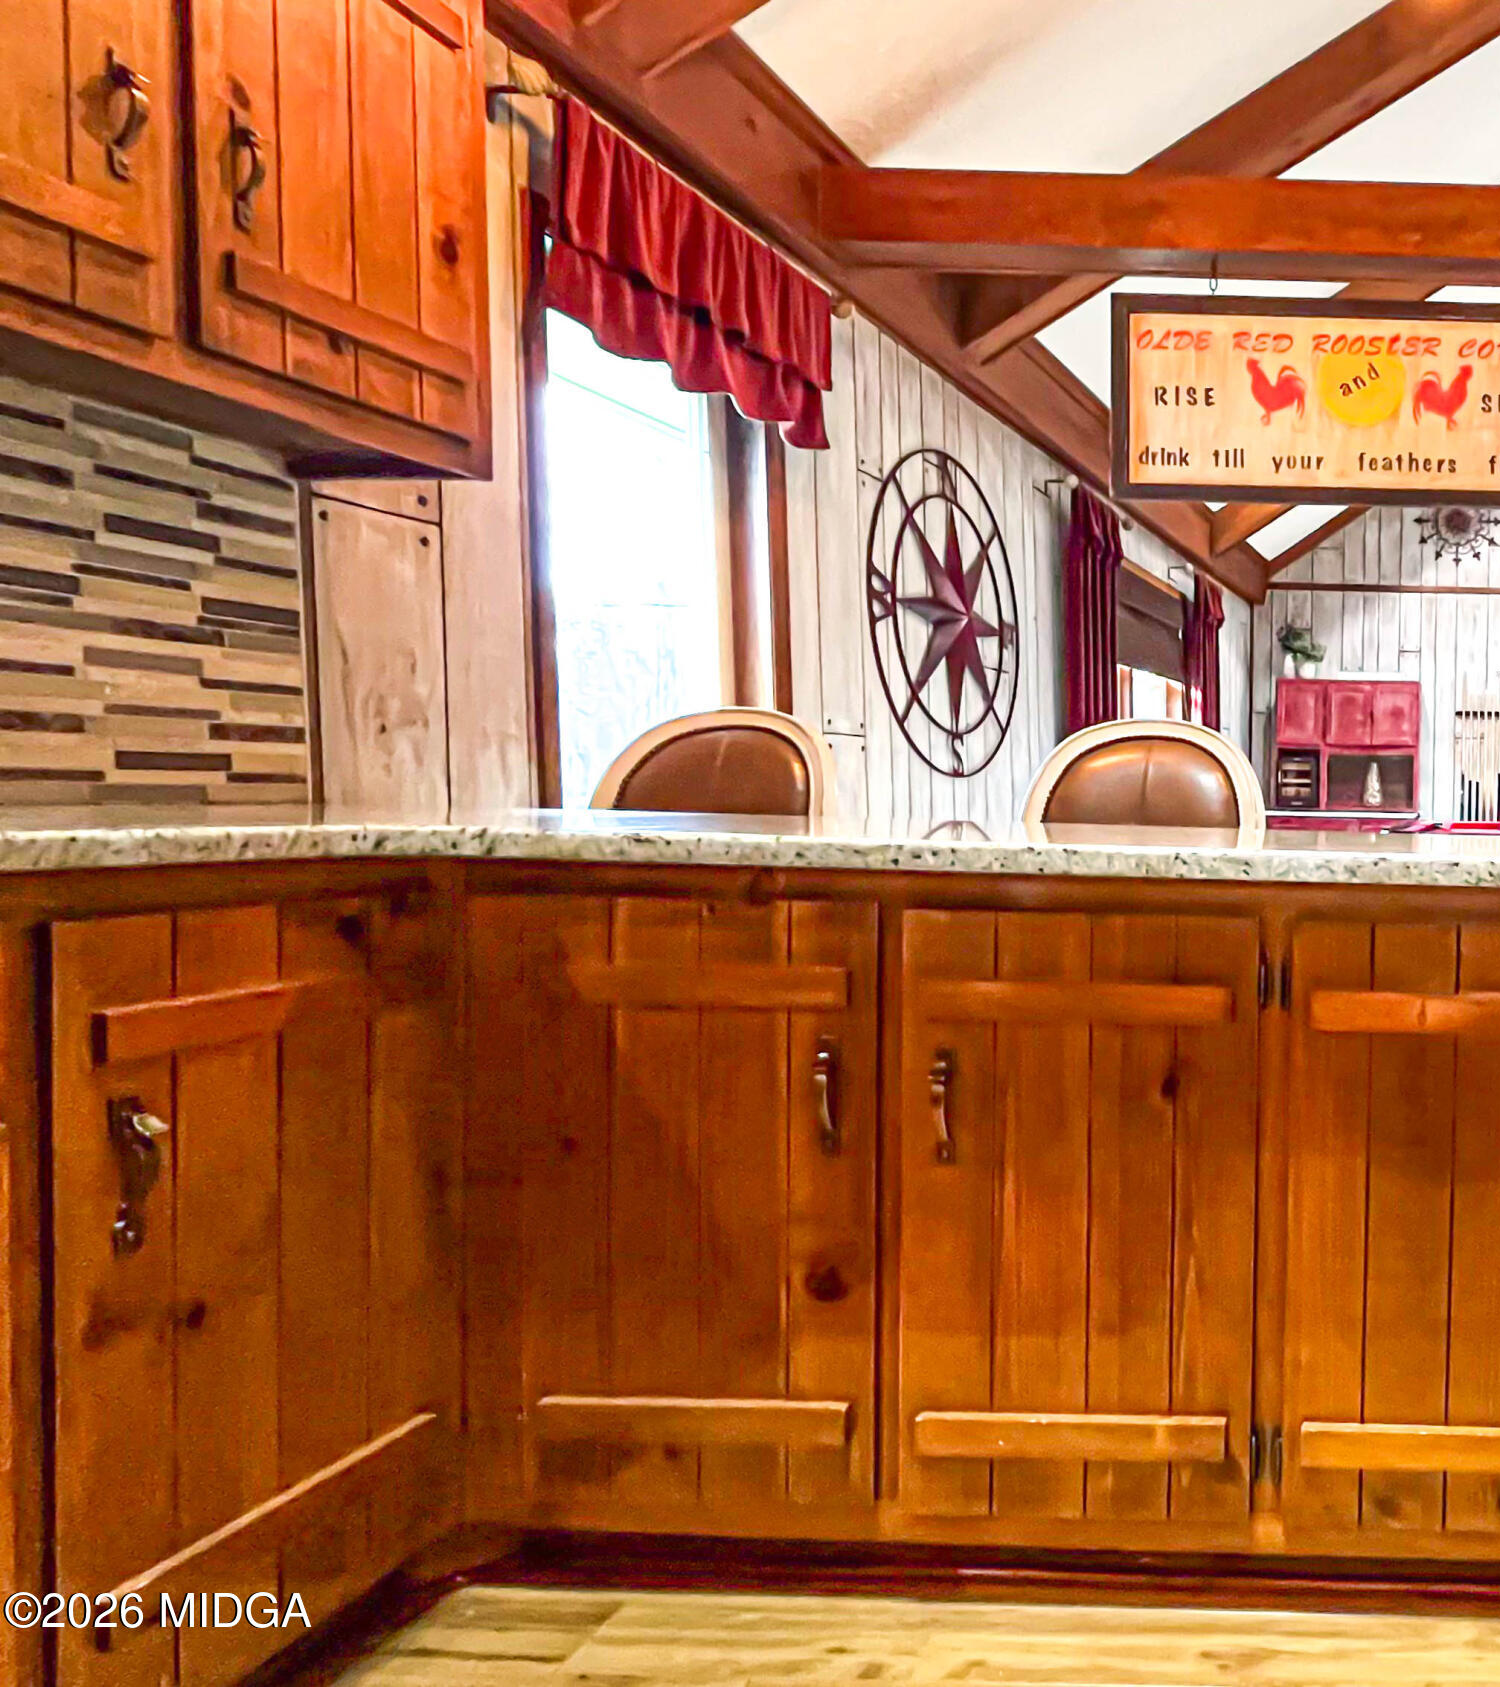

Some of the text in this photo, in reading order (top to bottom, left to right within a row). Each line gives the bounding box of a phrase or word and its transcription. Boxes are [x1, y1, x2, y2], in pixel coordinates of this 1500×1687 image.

[1136, 329, 1213, 353] OLDE
[1232, 332, 1294, 354] RED
[1154, 386, 1216, 407] RISE
[1339, 363, 1380, 398] and
[1138, 445, 1190, 468] drink
[1212, 448, 1245, 469] till
[1272, 454, 1324, 474] your
[1359, 452, 1457, 474] feathers
